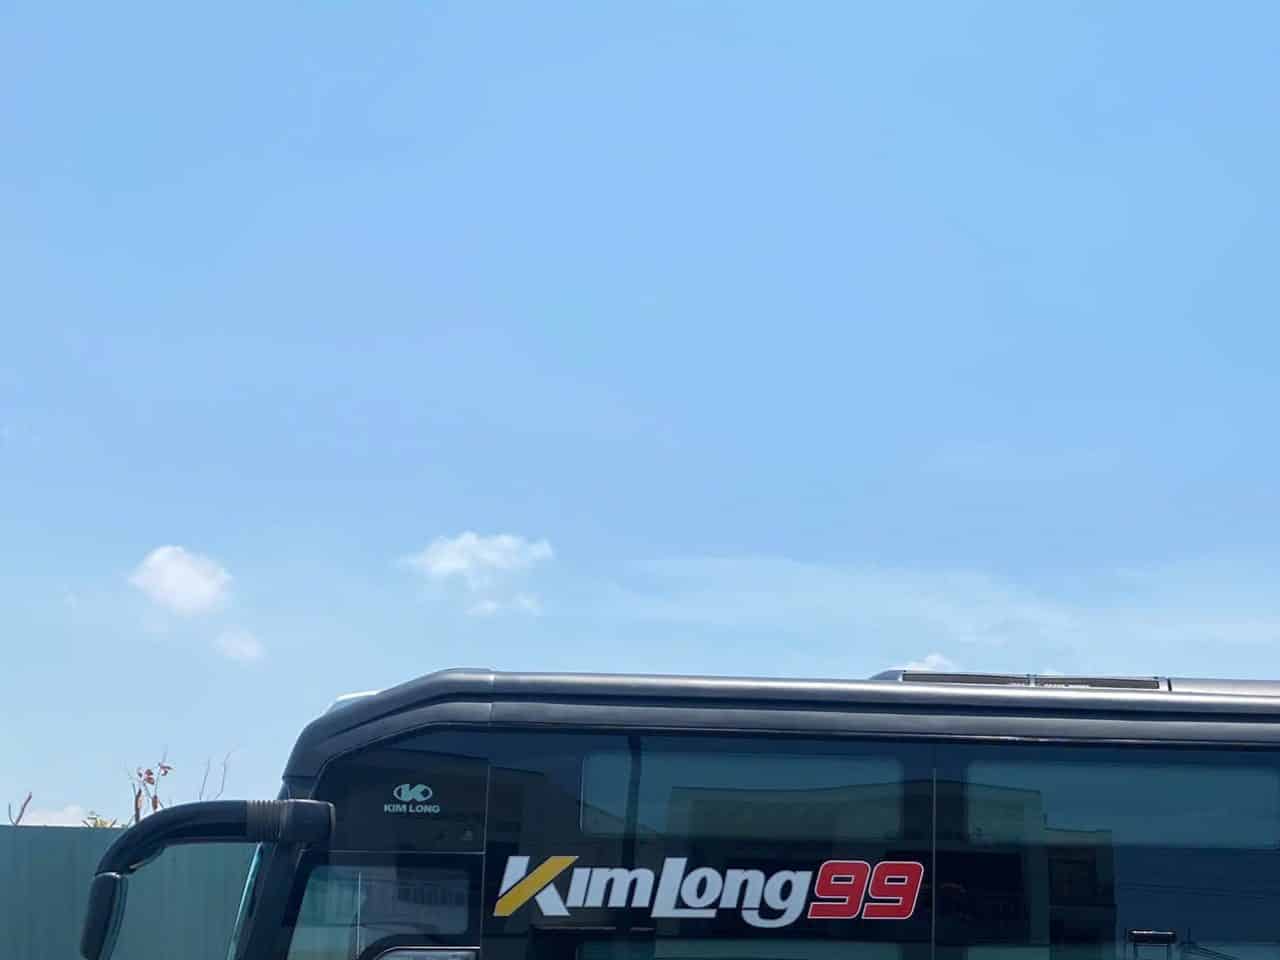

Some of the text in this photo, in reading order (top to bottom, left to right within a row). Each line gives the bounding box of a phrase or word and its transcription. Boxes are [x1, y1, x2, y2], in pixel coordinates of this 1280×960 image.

[383, 803, 441, 813] KIM LONG
[493, 855, 924, 928] KimLong99
